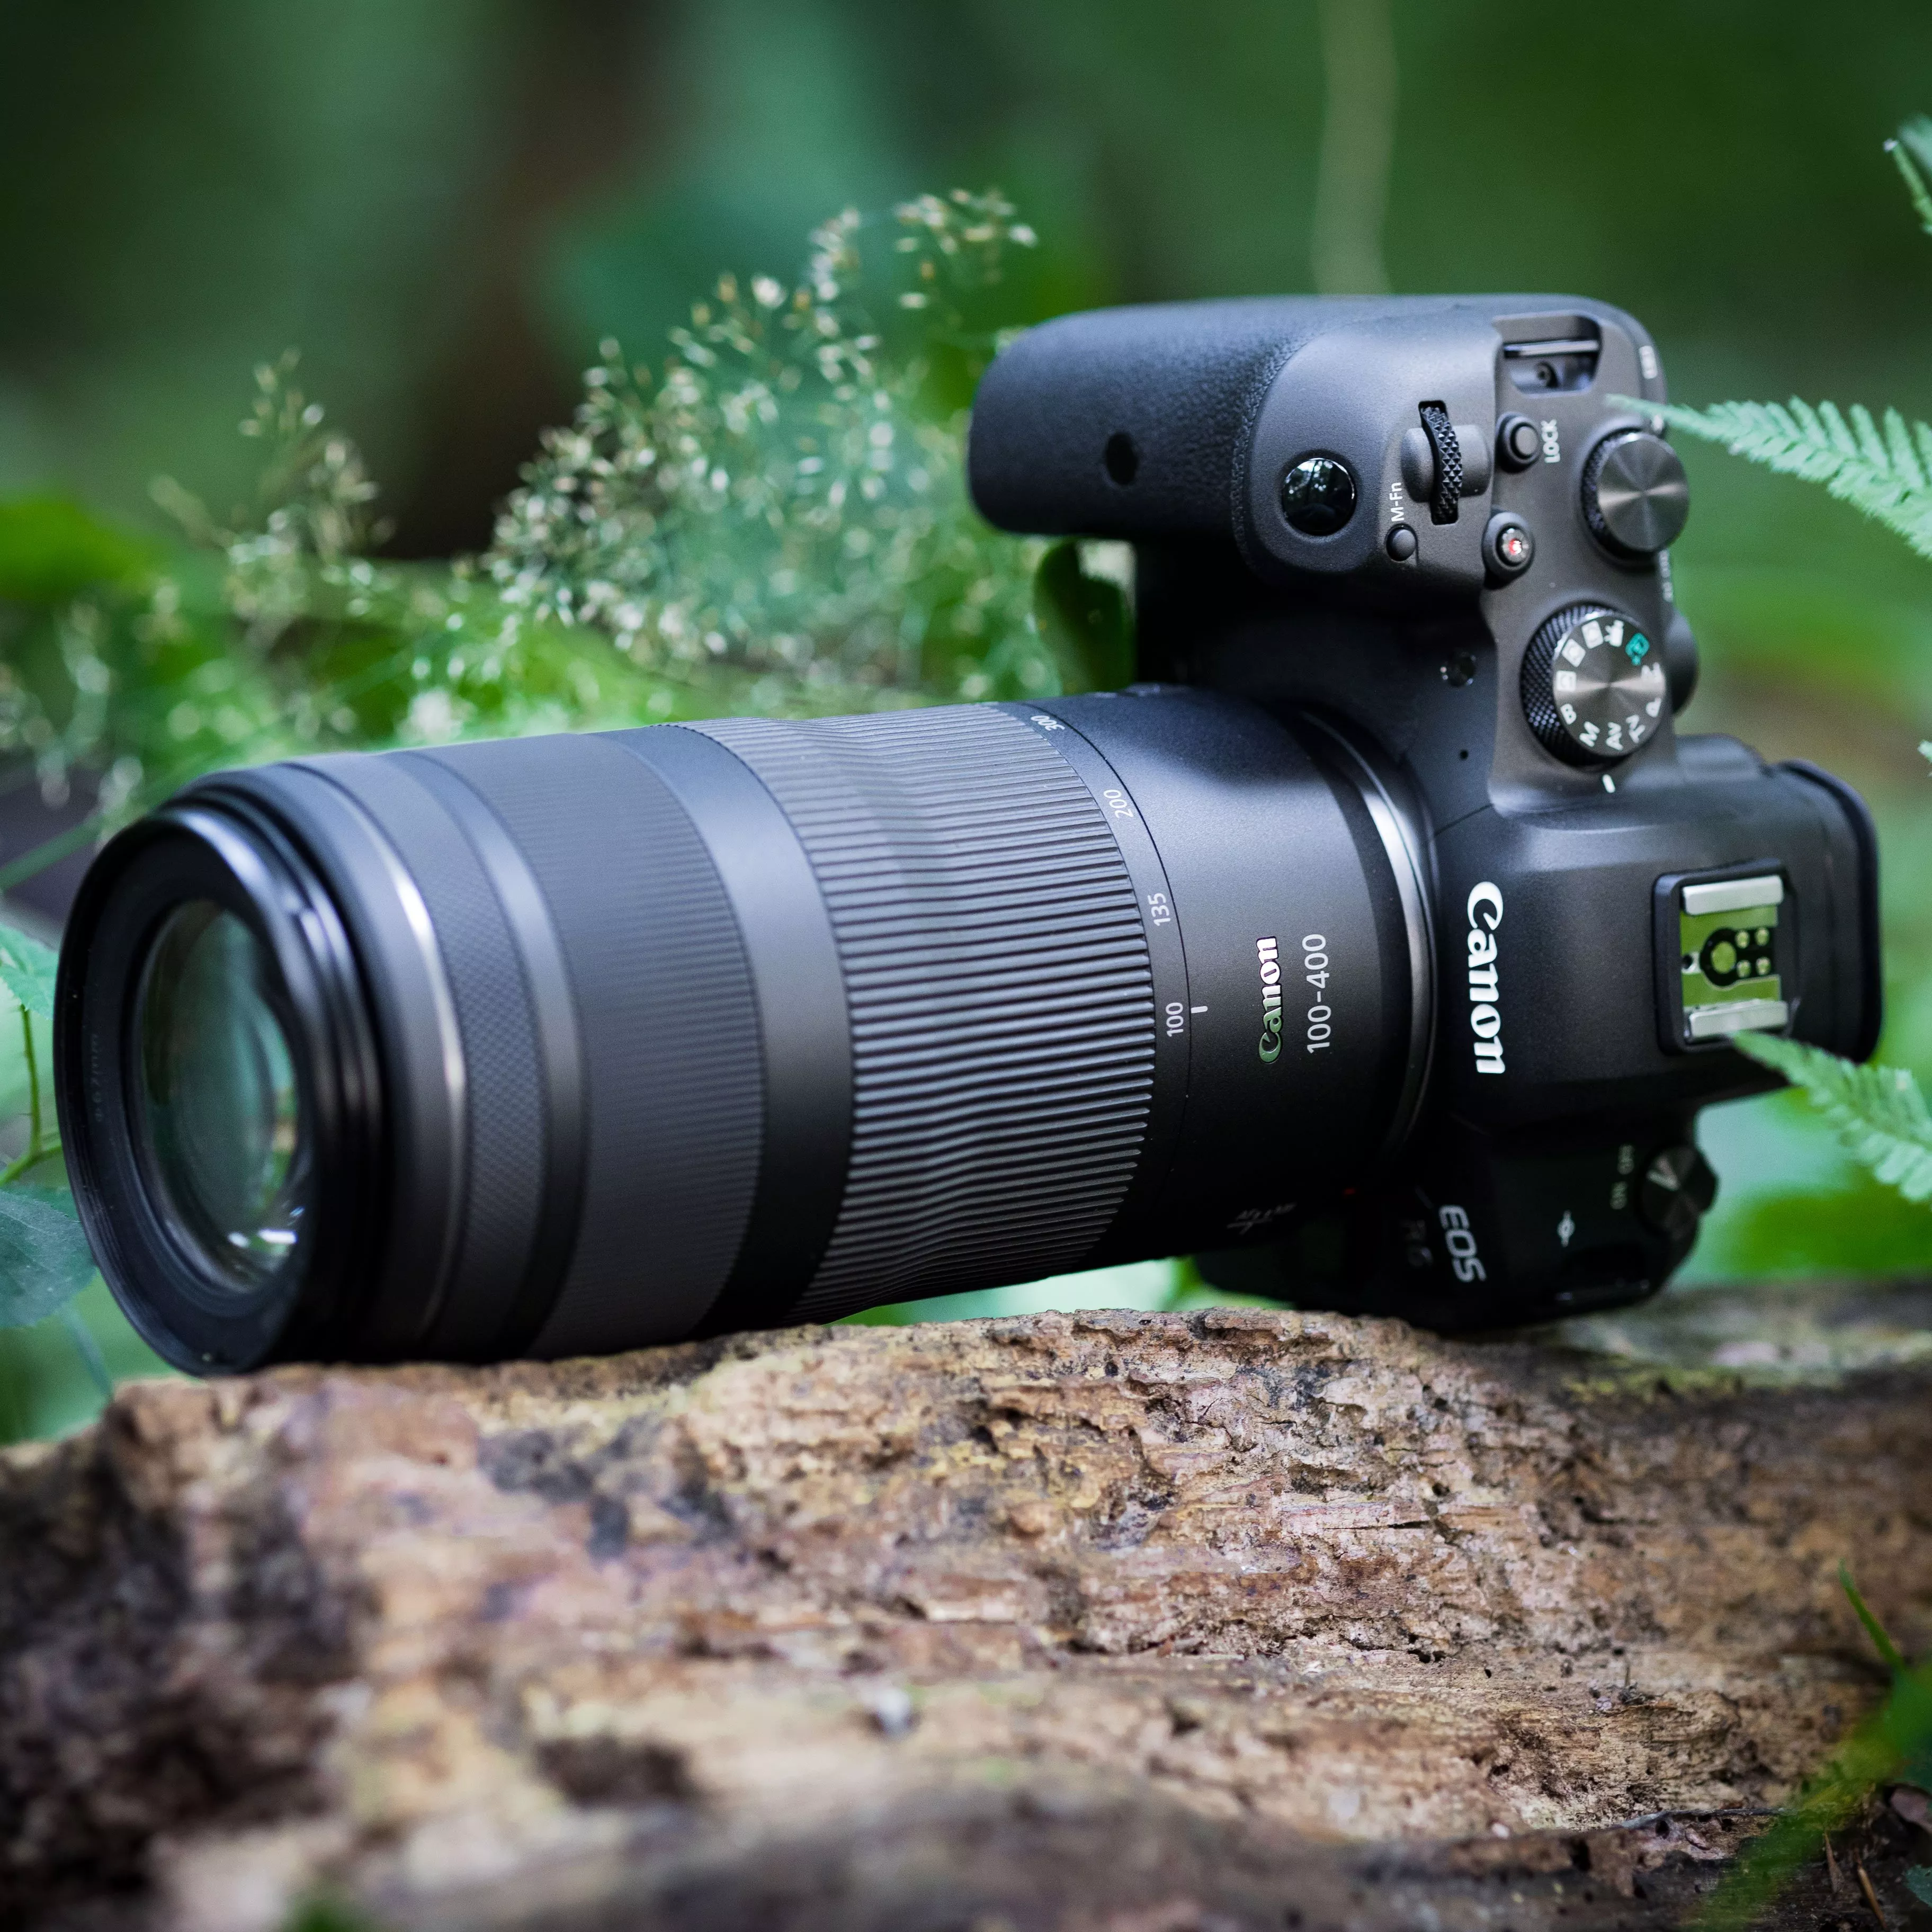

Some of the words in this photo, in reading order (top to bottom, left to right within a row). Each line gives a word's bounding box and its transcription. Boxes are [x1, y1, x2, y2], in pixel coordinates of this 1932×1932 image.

[1540, 418, 1560, 463] LOCK
[1389, 482, 1405, 522] M-Fn
[1030, 714, 1066, 732] 300
[1560, 703, 1577, 724] B
[1645, 697, 1661, 717] P
[1579, 721, 1600, 747] M
[1606, 722, 1623, 750] Av
[1103, 789, 1134, 819] 200
[1147, 892, 1171, 926] 135
[1302, 933, 1332, 1053] 100-400
[1467, 881, 1506, 1074] Canon
[1256, 935, 1283, 1064] Canon
[1165, 1002, 1184, 1037] 100
[1439, 1205, 1487, 1283] EOS
